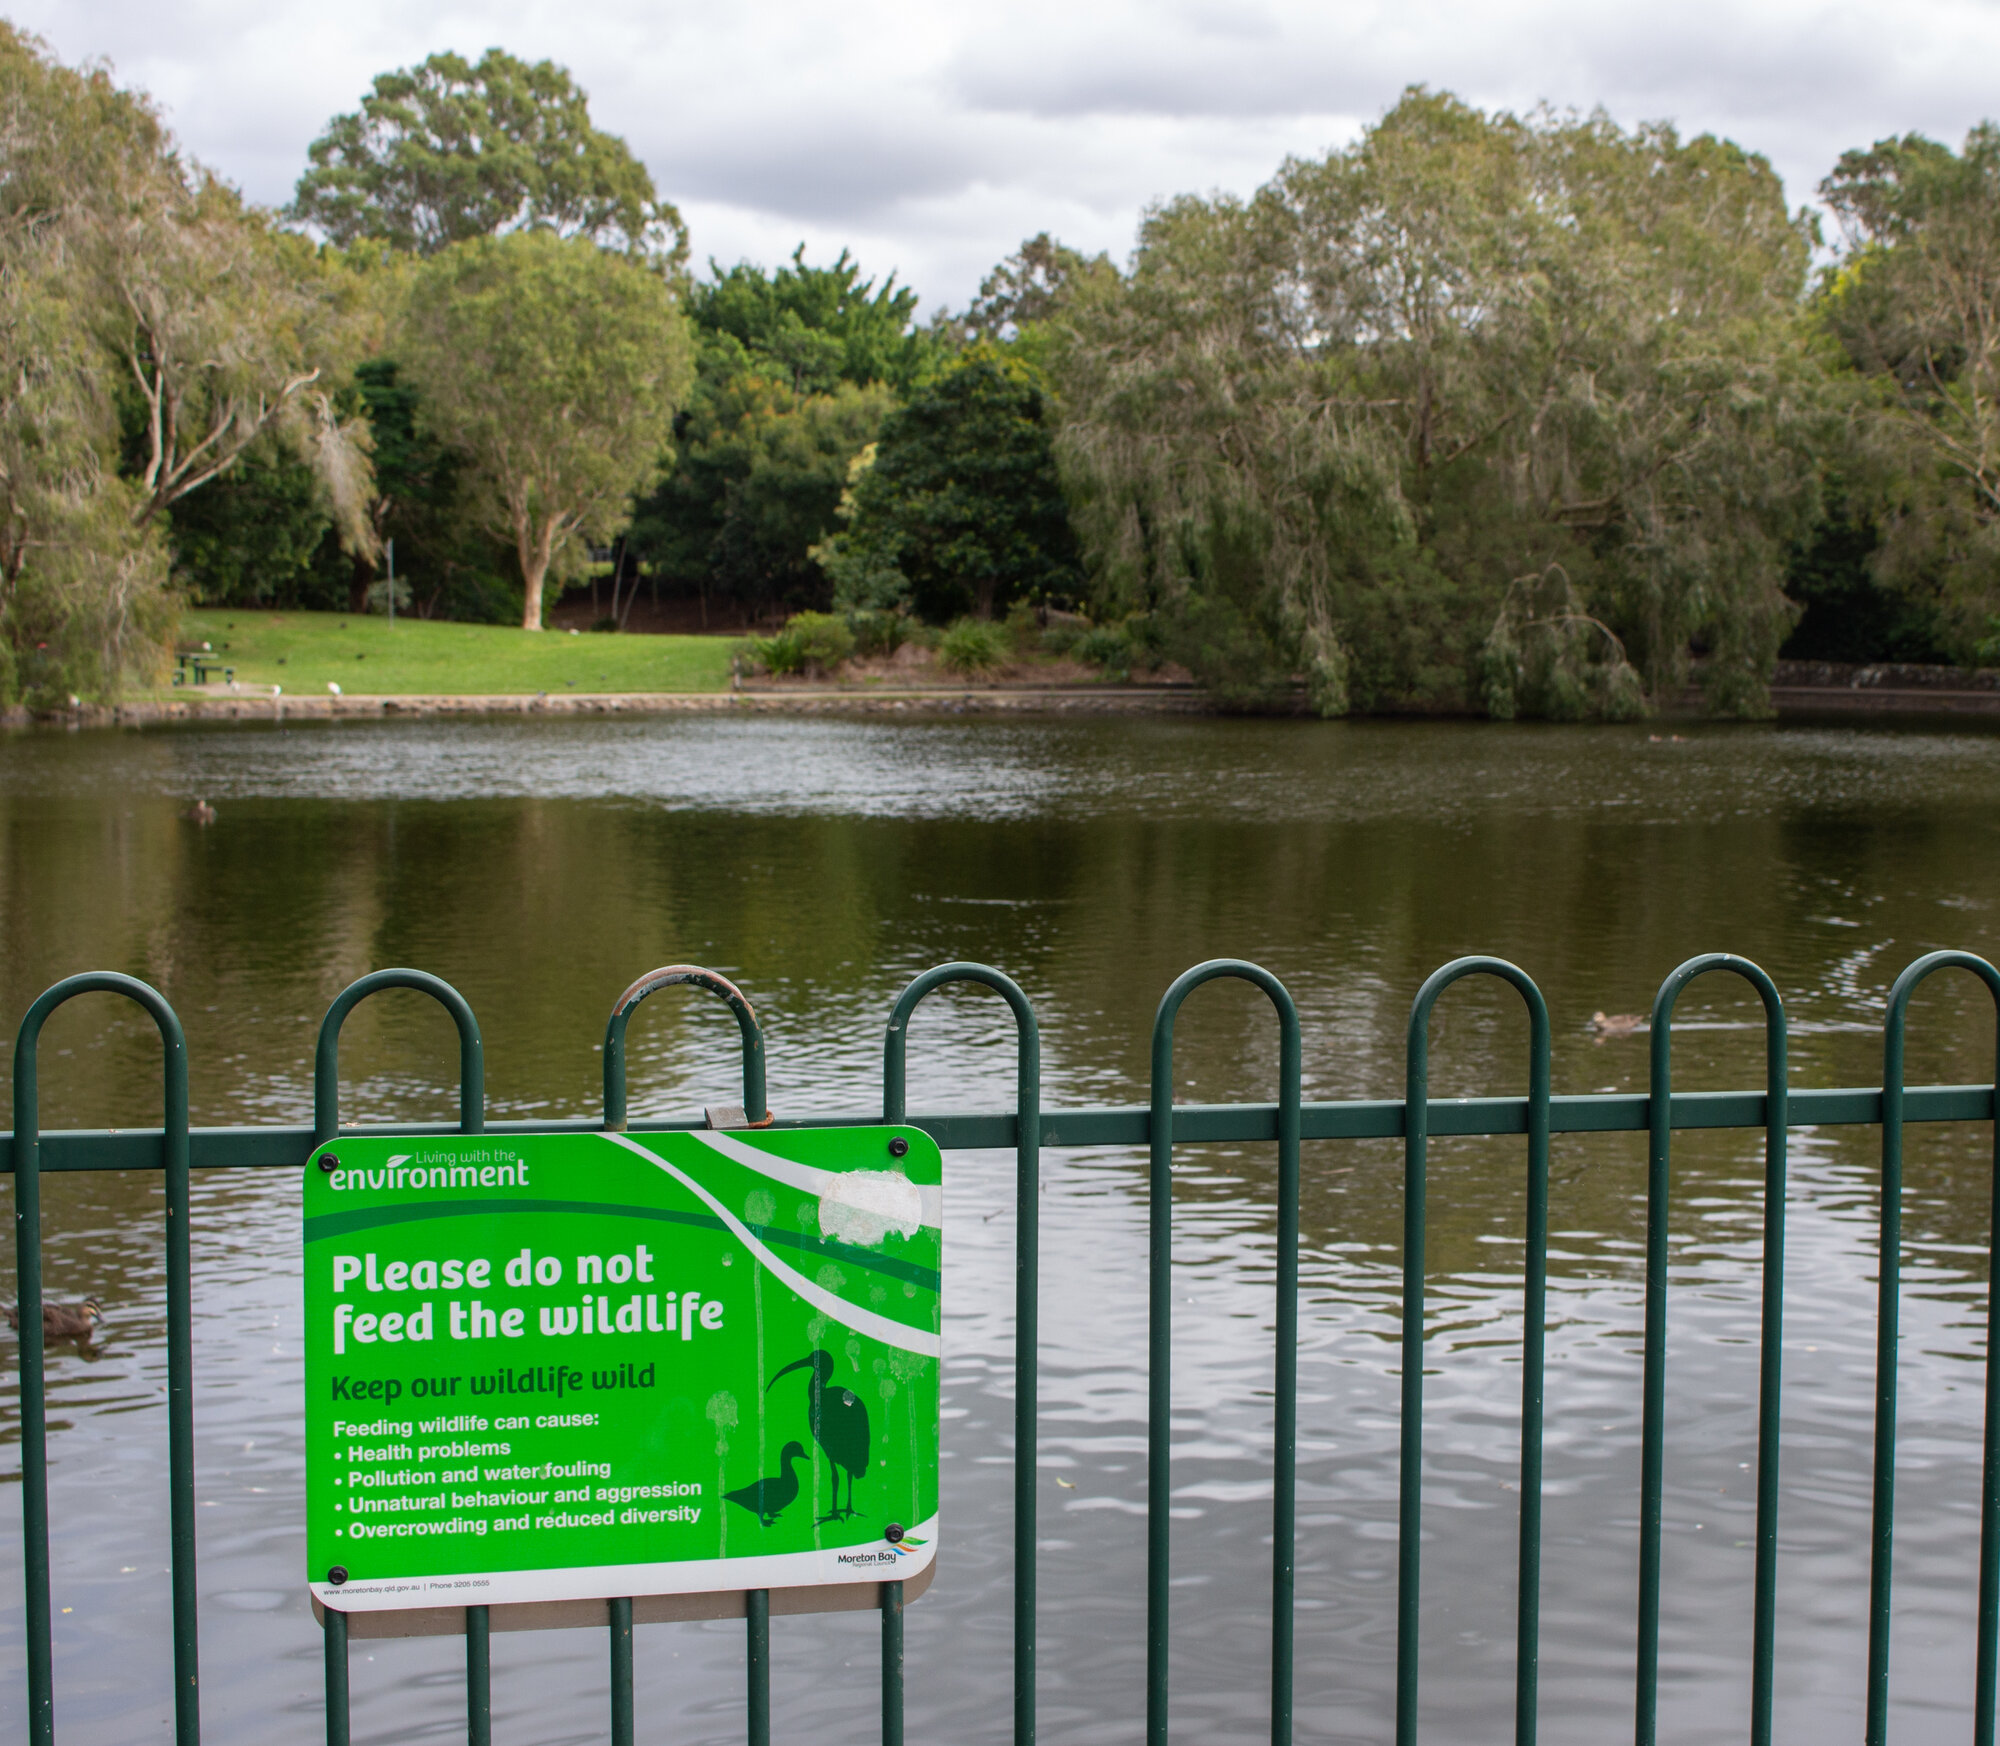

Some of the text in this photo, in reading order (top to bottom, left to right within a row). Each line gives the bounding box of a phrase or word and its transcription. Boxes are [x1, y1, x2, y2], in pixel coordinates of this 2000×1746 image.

[416, 1149, 516, 1166] Living with the
[330, 1159, 529, 1190] environment
[333, 1245, 653, 1292] Please do not
[333, 1292, 724, 1354] feed the wildlife
[332, 1363, 655, 1405] Keep our wildlife wild
[334, 1412, 599, 1437] Feeding wildlife can cause:
[348, 1440, 510, 1463] Health problems
[349, 1460, 611, 1488] Pollution and water fouling
[349, 1482, 702, 1513] Unnatural behaviour and aggression
[349, 1505, 701, 1539] Overcrowding and reduced diversity
[838, 1553, 896, 1563] Moreton Bay
[324, 1585, 420, 1595] www.moretonbay.qld.gov.au
